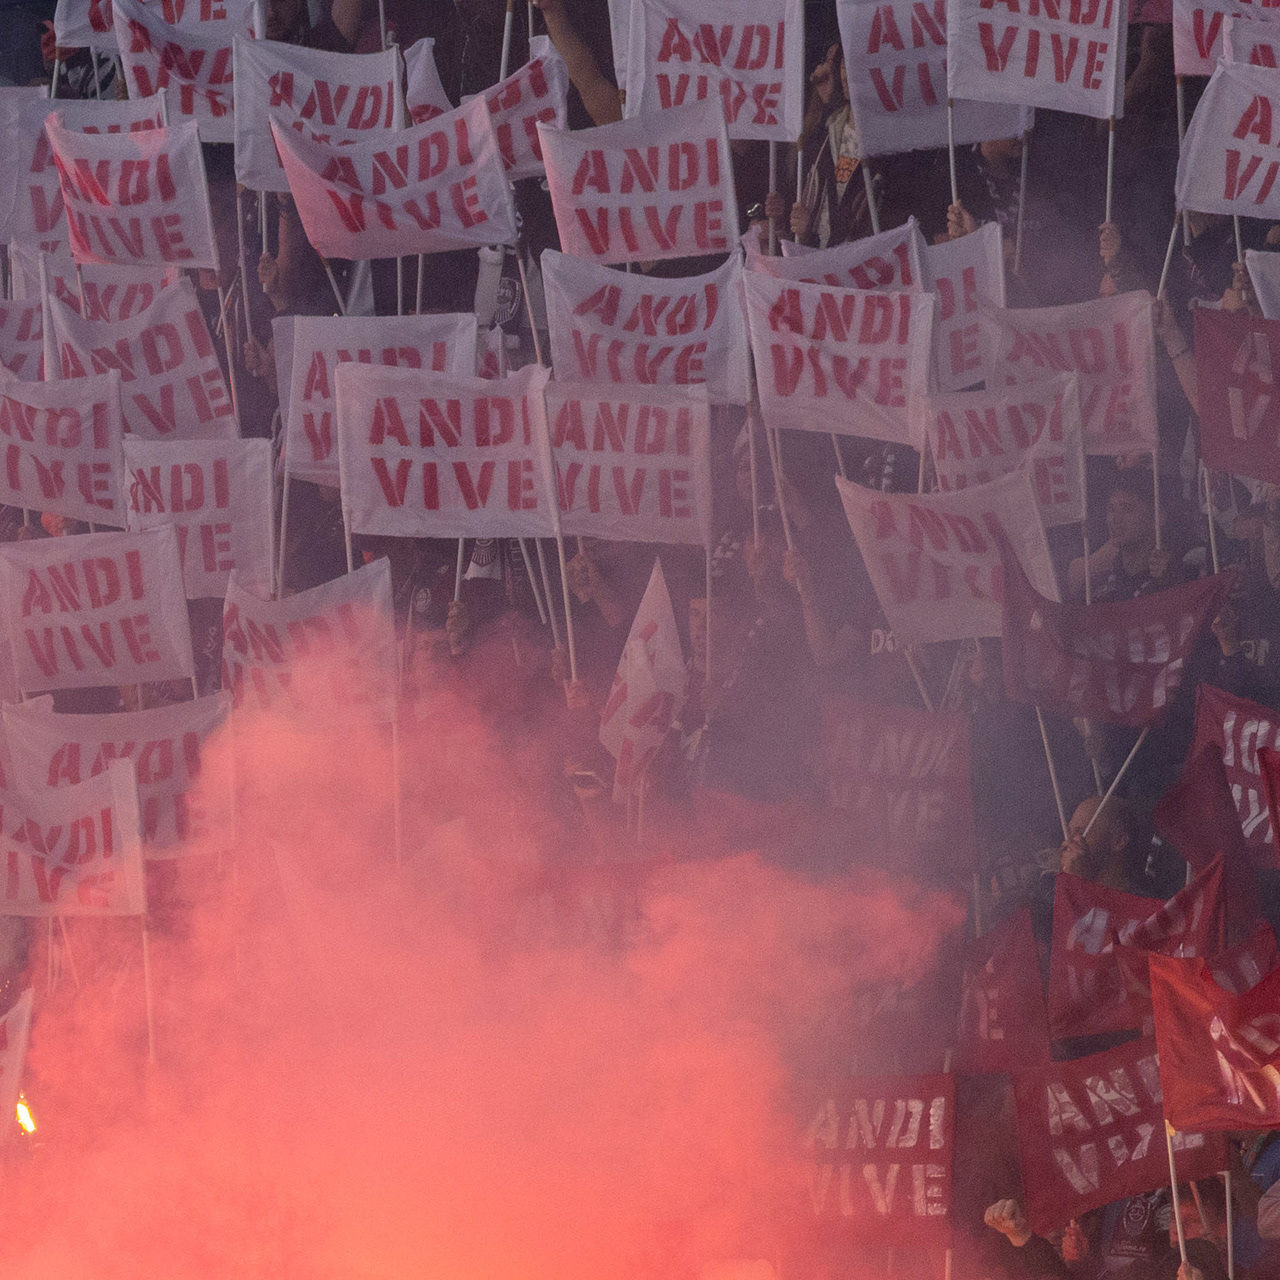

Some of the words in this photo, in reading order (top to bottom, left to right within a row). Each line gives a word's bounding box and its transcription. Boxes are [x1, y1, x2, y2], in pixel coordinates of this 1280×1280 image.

[658, 18, 785, 72] ANDI
[866, 2, 946, 54] AN
[979, 22, 1110, 90] VIVE
[869, 62, 946, 112] VI
[52, 154, 178, 206] ANDI
[322, 118, 475, 192] ANDI
[571, 138, 719, 195] ANDI
[328, 176, 489, 232] VIVE
[575, 200, 728, 255] VIVE
[575, 282, 718, 336] ANDI
[768, 289, 912, 345] ANDI
[60, 308, 214, 378] ANDI
[572, 329, 709, 385] VIVE
[769, 345, 908, 408] VIVE
[368, 396, 532, 449] ANDI
[370, 458, 538, 510] VIVE
[22, 550, 141, 618] ANDI
[25, 615, 161, 678] VIVE
